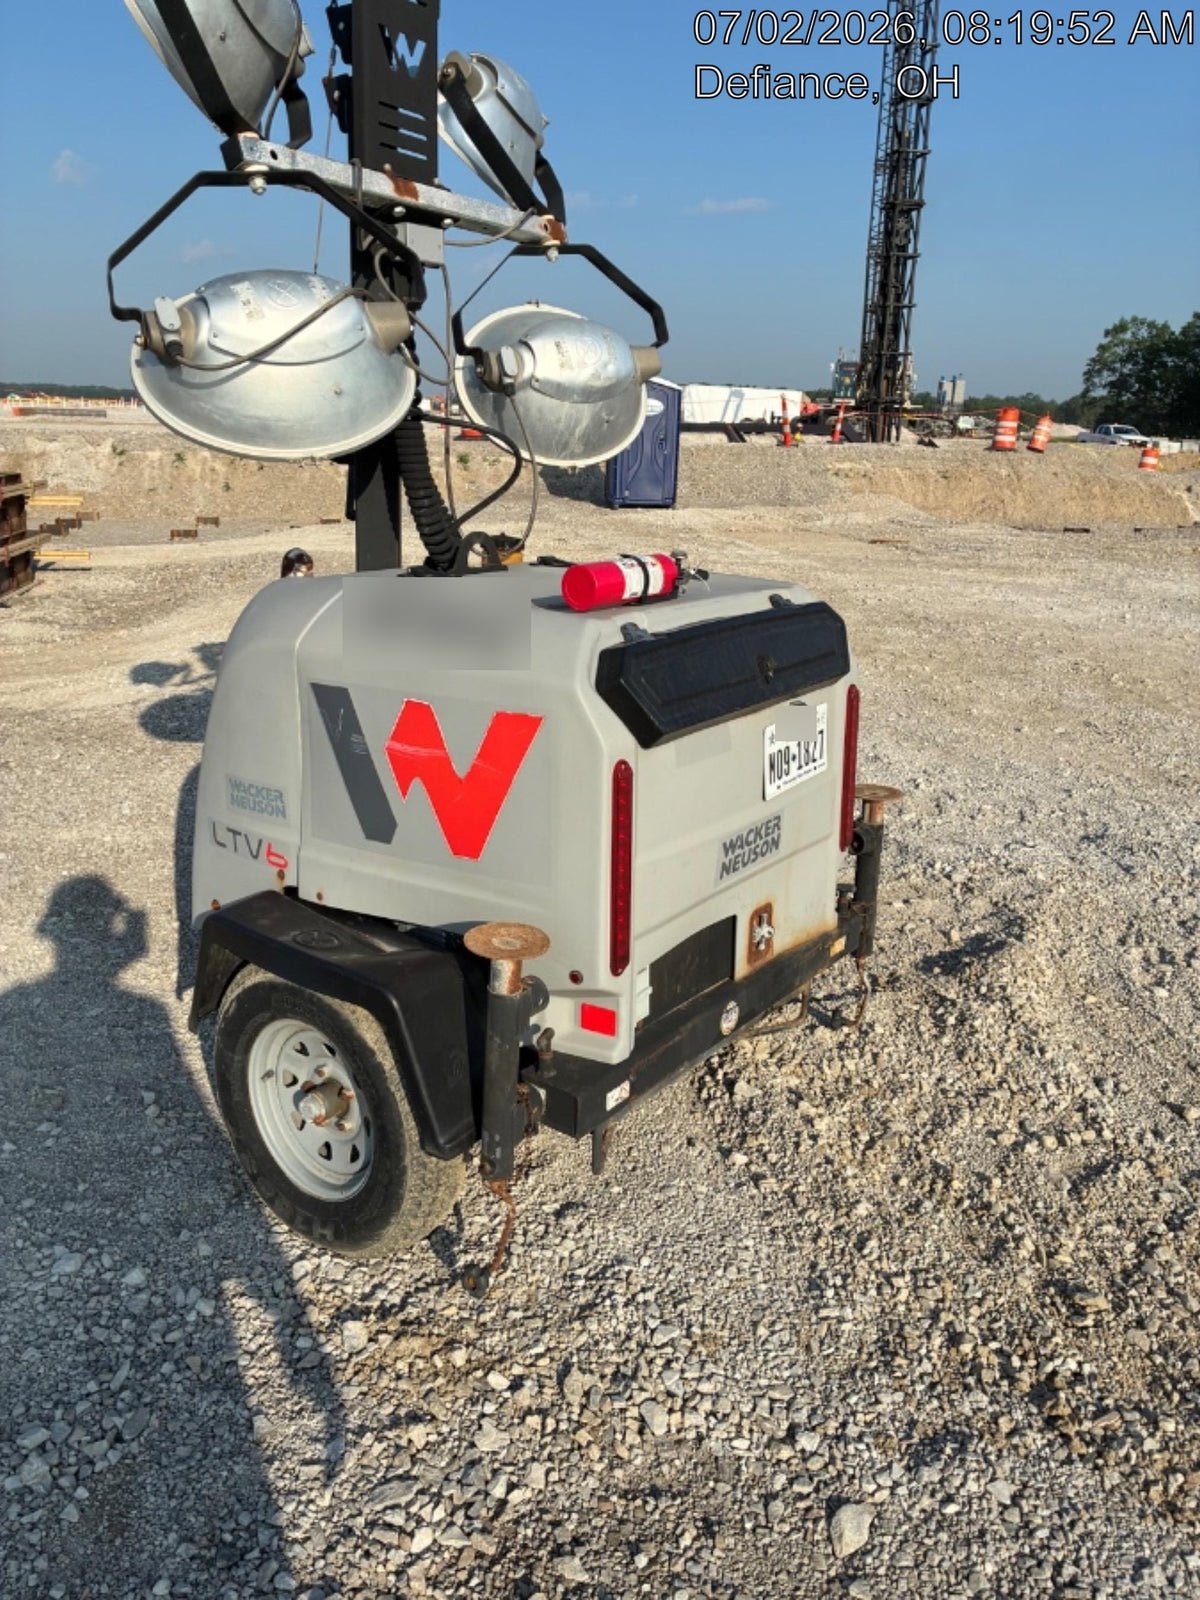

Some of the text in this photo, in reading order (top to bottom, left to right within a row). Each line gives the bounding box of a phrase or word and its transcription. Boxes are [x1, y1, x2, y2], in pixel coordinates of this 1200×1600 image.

[229, 778, 284, 804] WACKER
[230, 792, 287, 820] NEUSON
[212, 820, 289, 869] LTV6
[719, 832, 781, 881] NEUSON
[722, 814, 781, 859] WACKER
